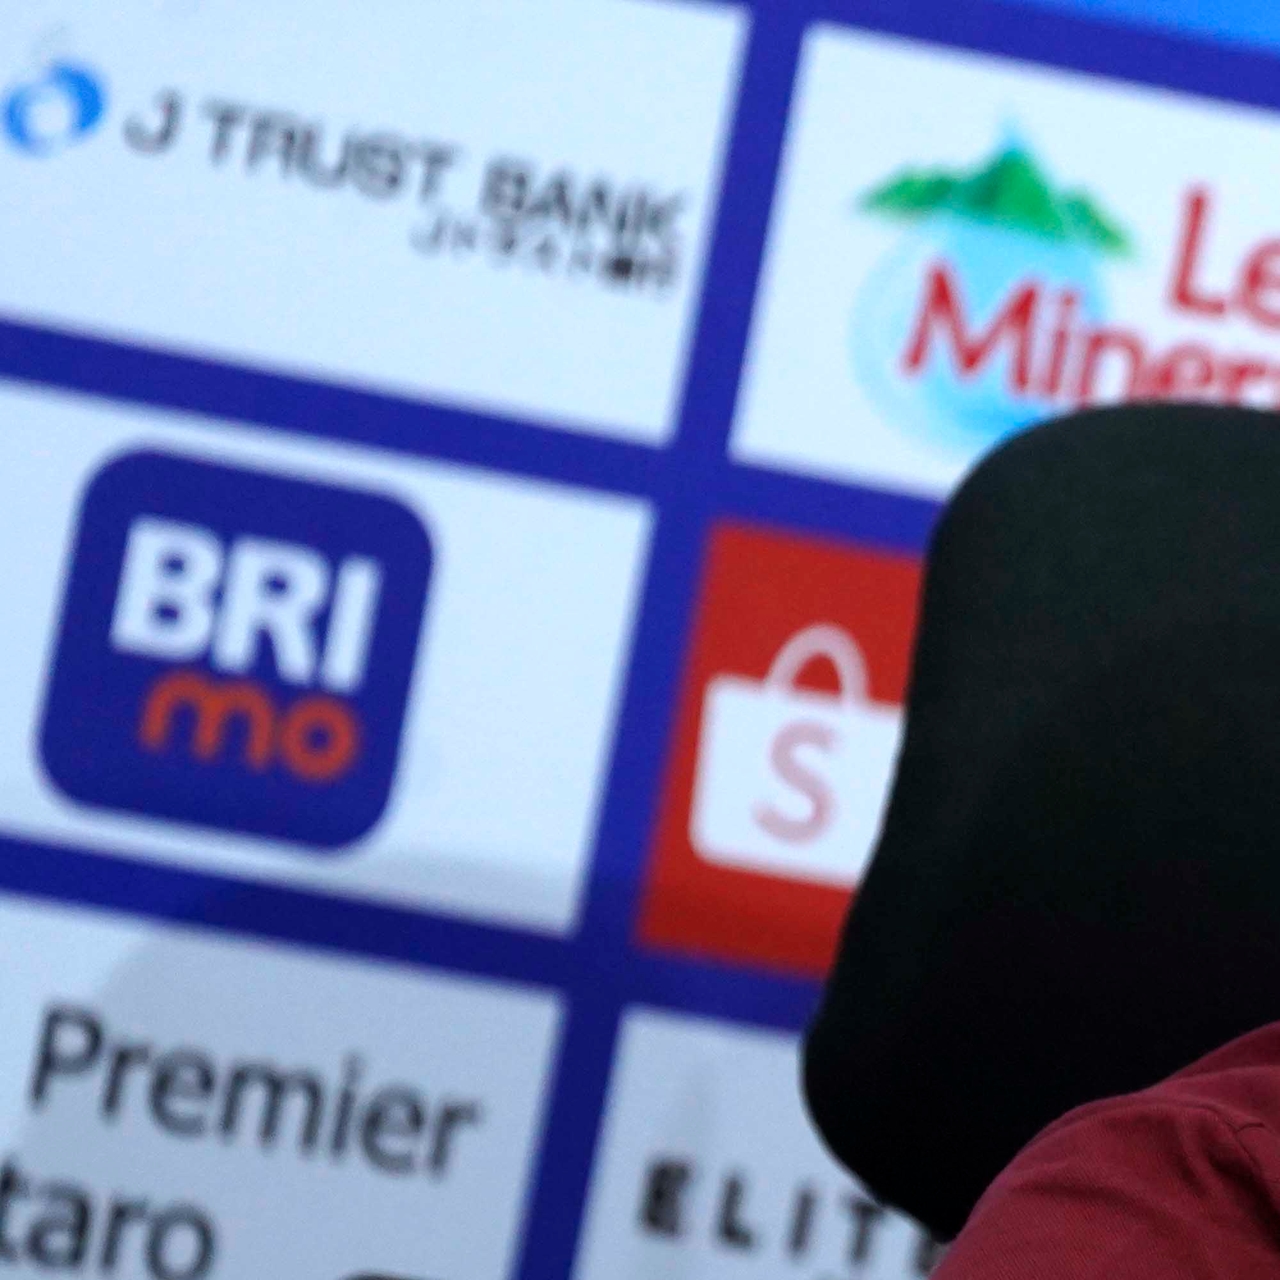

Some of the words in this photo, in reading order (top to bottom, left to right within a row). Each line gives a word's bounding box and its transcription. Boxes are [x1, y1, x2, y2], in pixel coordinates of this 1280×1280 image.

[122, 88, 186, 155] J
[202, 98, 461, 206] TRUST
[478, 151, 690, 243] BANK
[105, 515, 384, 695] BRI
[137, 668, 360, 783] mo
[30, 1002, 484, 1180] Premier
